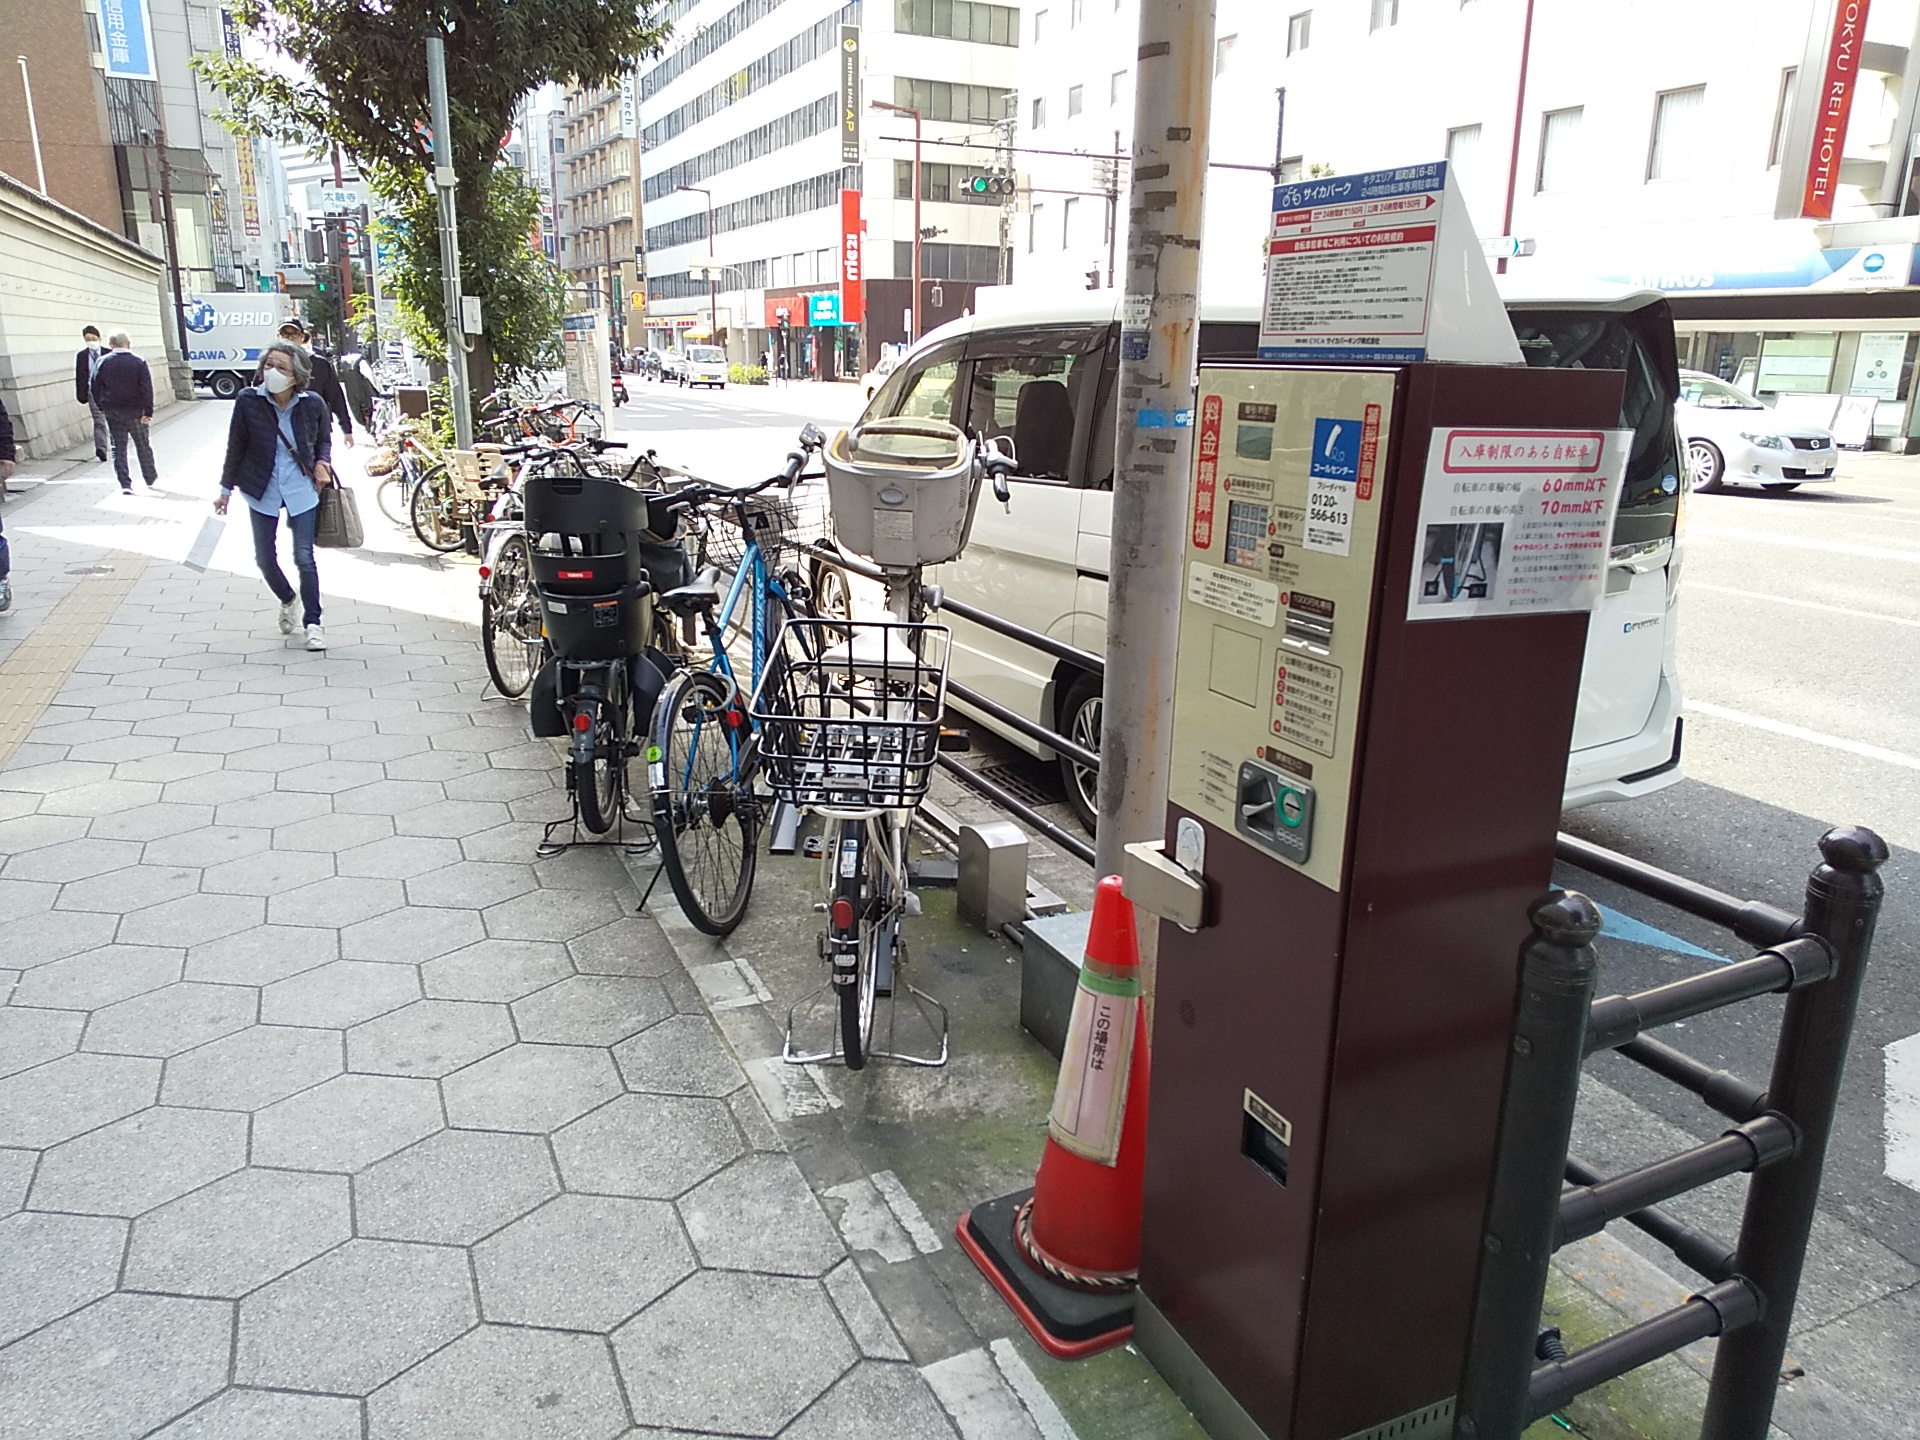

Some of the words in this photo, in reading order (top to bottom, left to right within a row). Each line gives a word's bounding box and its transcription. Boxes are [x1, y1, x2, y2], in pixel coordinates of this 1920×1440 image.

[104, 0, 131, 64] 信用金庫
[1828, 82, 1844, 116] REI
[846, 109, 855, 132] AP
[1812, 126, 1837, 202] HOTEL
[1363, 172, 1393, 185] キタエリア
[324, 192, 356, 203] 太融寺
[1304, 181, 1352, 201] サイカパーク
[204, 311, 273, 326] HYBRID
[188, 351, 227, 361] GAWA
[1459, 443, 1590, 460] 入庫制限のある自転車
[1195, 401, 1220, 544] 料金精算機
[1313, 464, 1354, 475] コールセンター
[1317, 482, 1347, 493] フリーダイヤル
[1453, 481, 1522, 493] 自転車の車輪の幅
[1542, 477, 1608, 493] 60mm以下
[1312, 493, 1338, 508] 0120-
[1450, 504, 1525, 516] 自転車の車輪の高さ
[1541, 499, 1605, 516] 70mm以下
[1310, 508, 1348, 525] 566-613
[1091, 1005, 1111, 1071] この場所は
